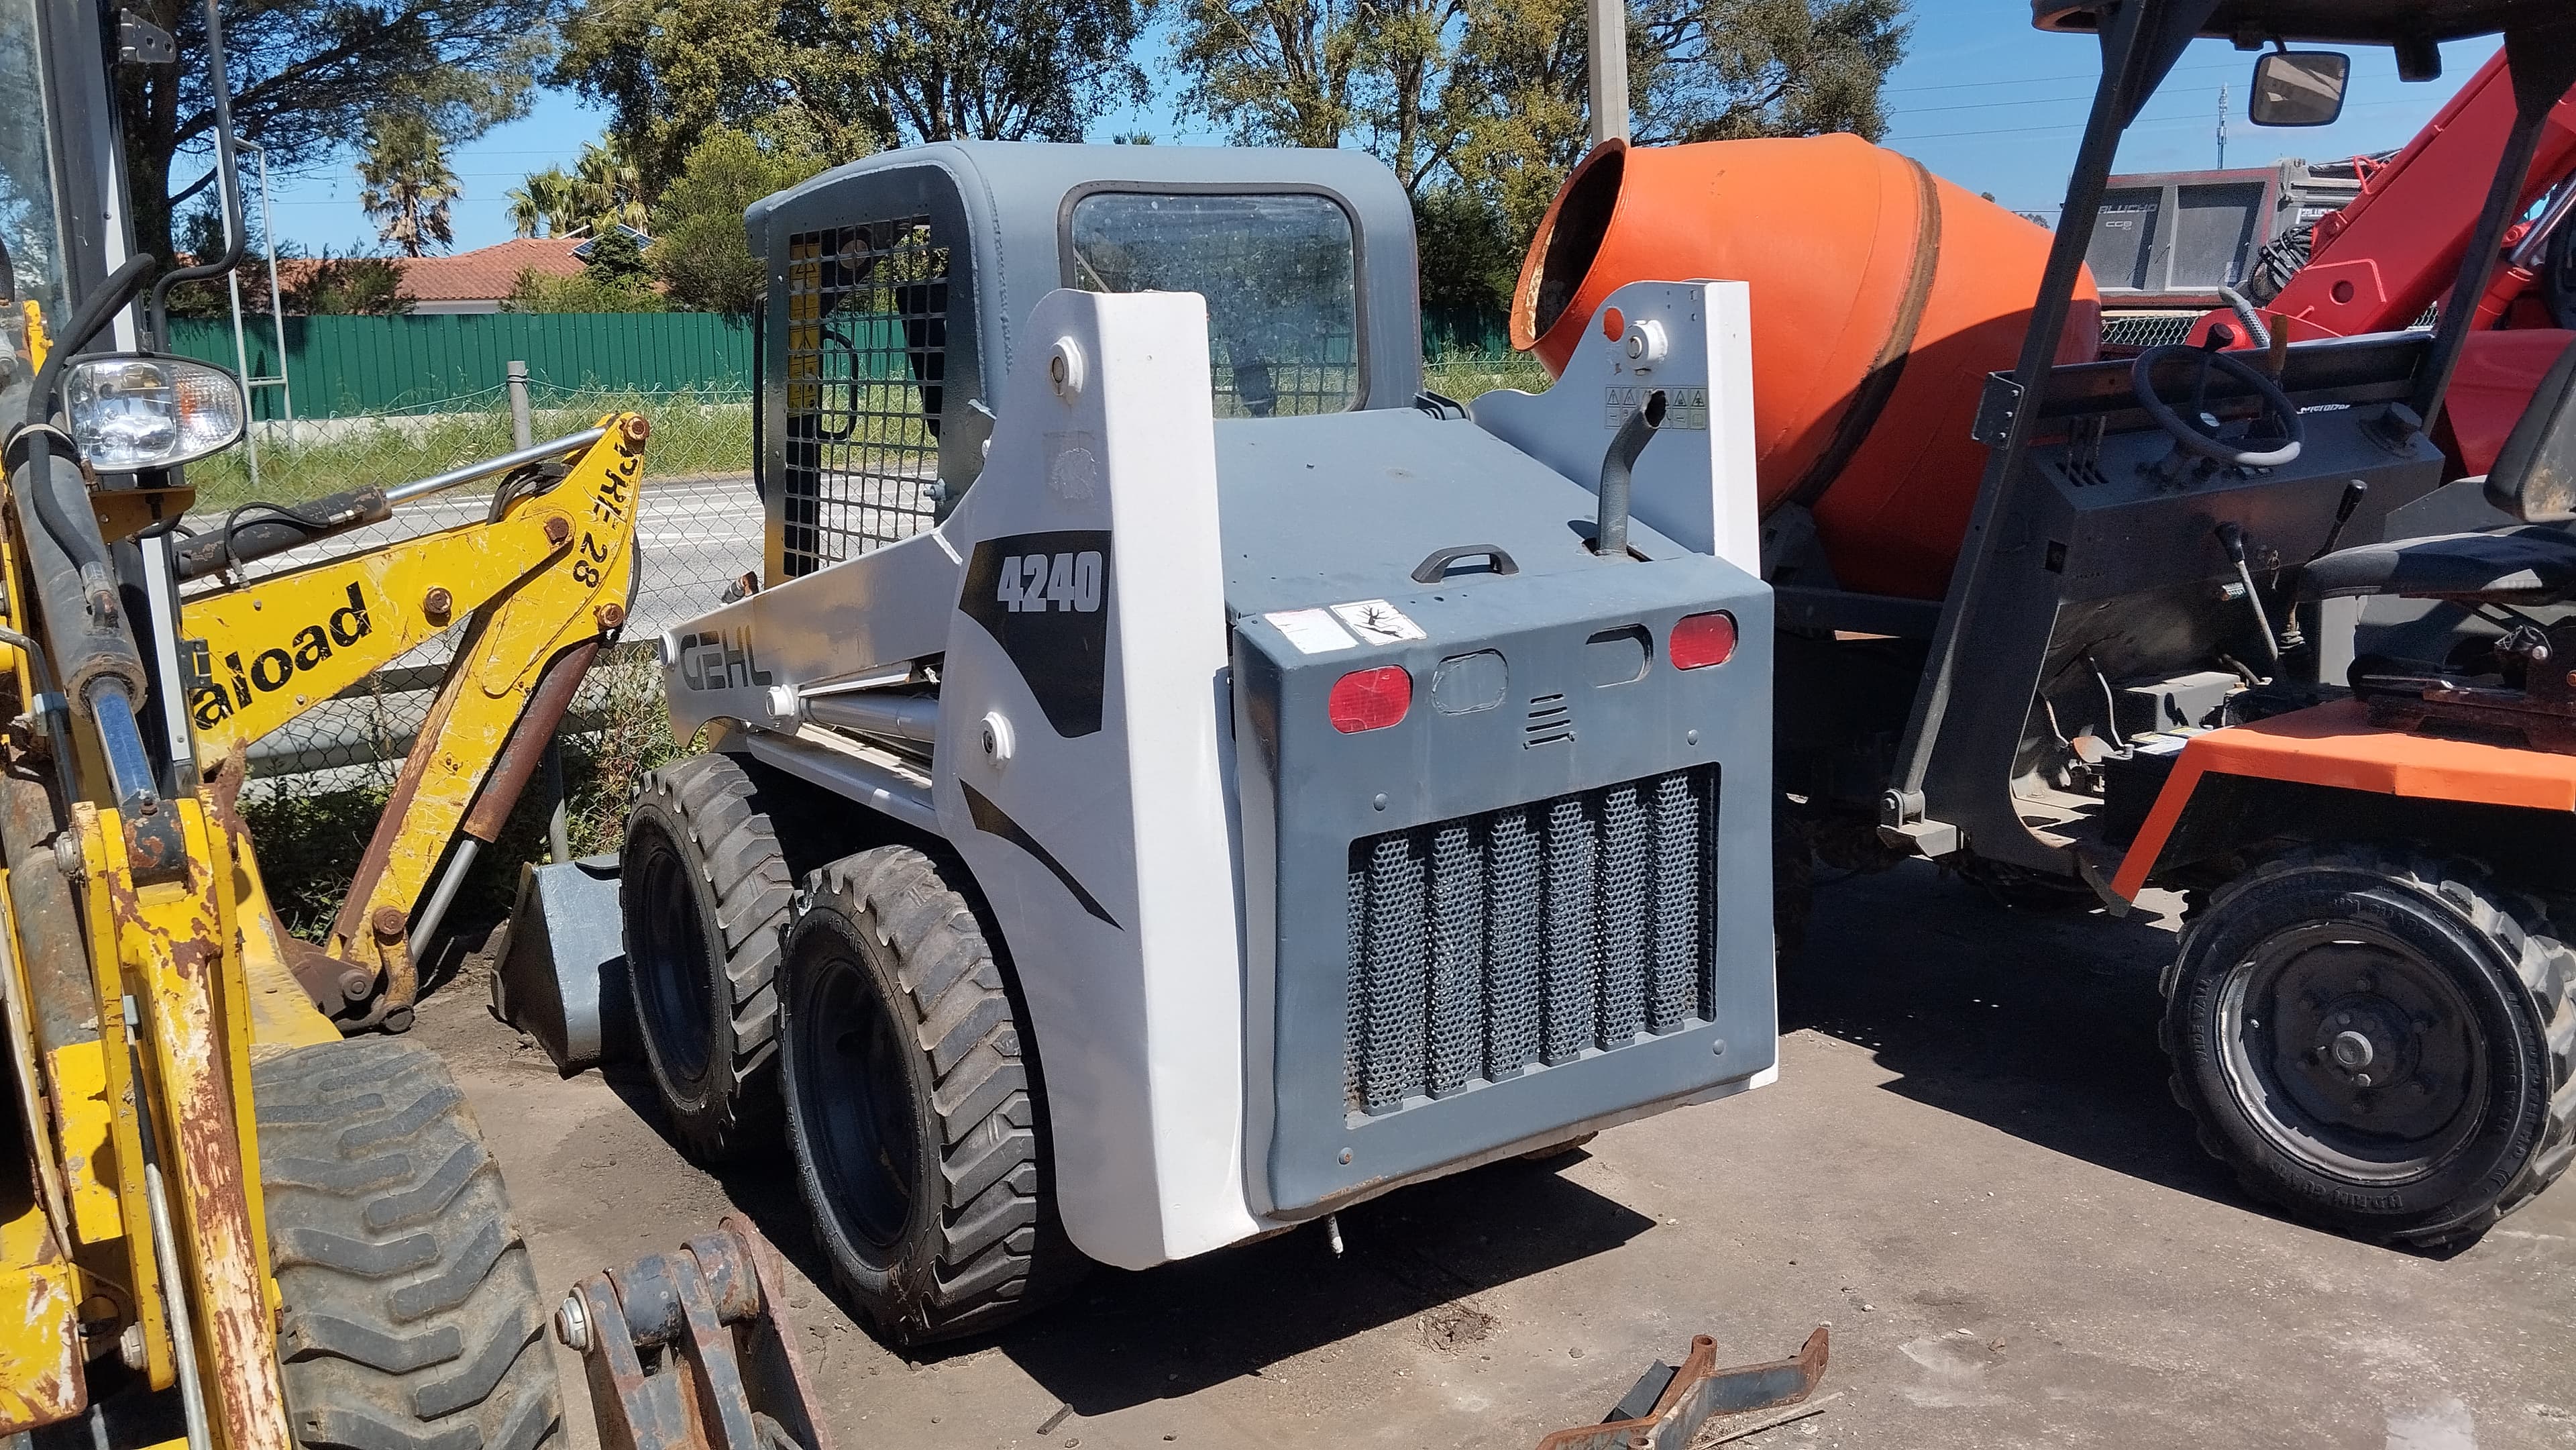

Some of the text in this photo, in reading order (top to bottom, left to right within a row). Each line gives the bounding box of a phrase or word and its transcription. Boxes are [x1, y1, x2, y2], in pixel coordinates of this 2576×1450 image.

[573, 531, 608, 588] 28
[997, 550, 1102, 613] 4240
[193, 580, 373, 731] aload
[680, 625, 773, 691] GEHL
